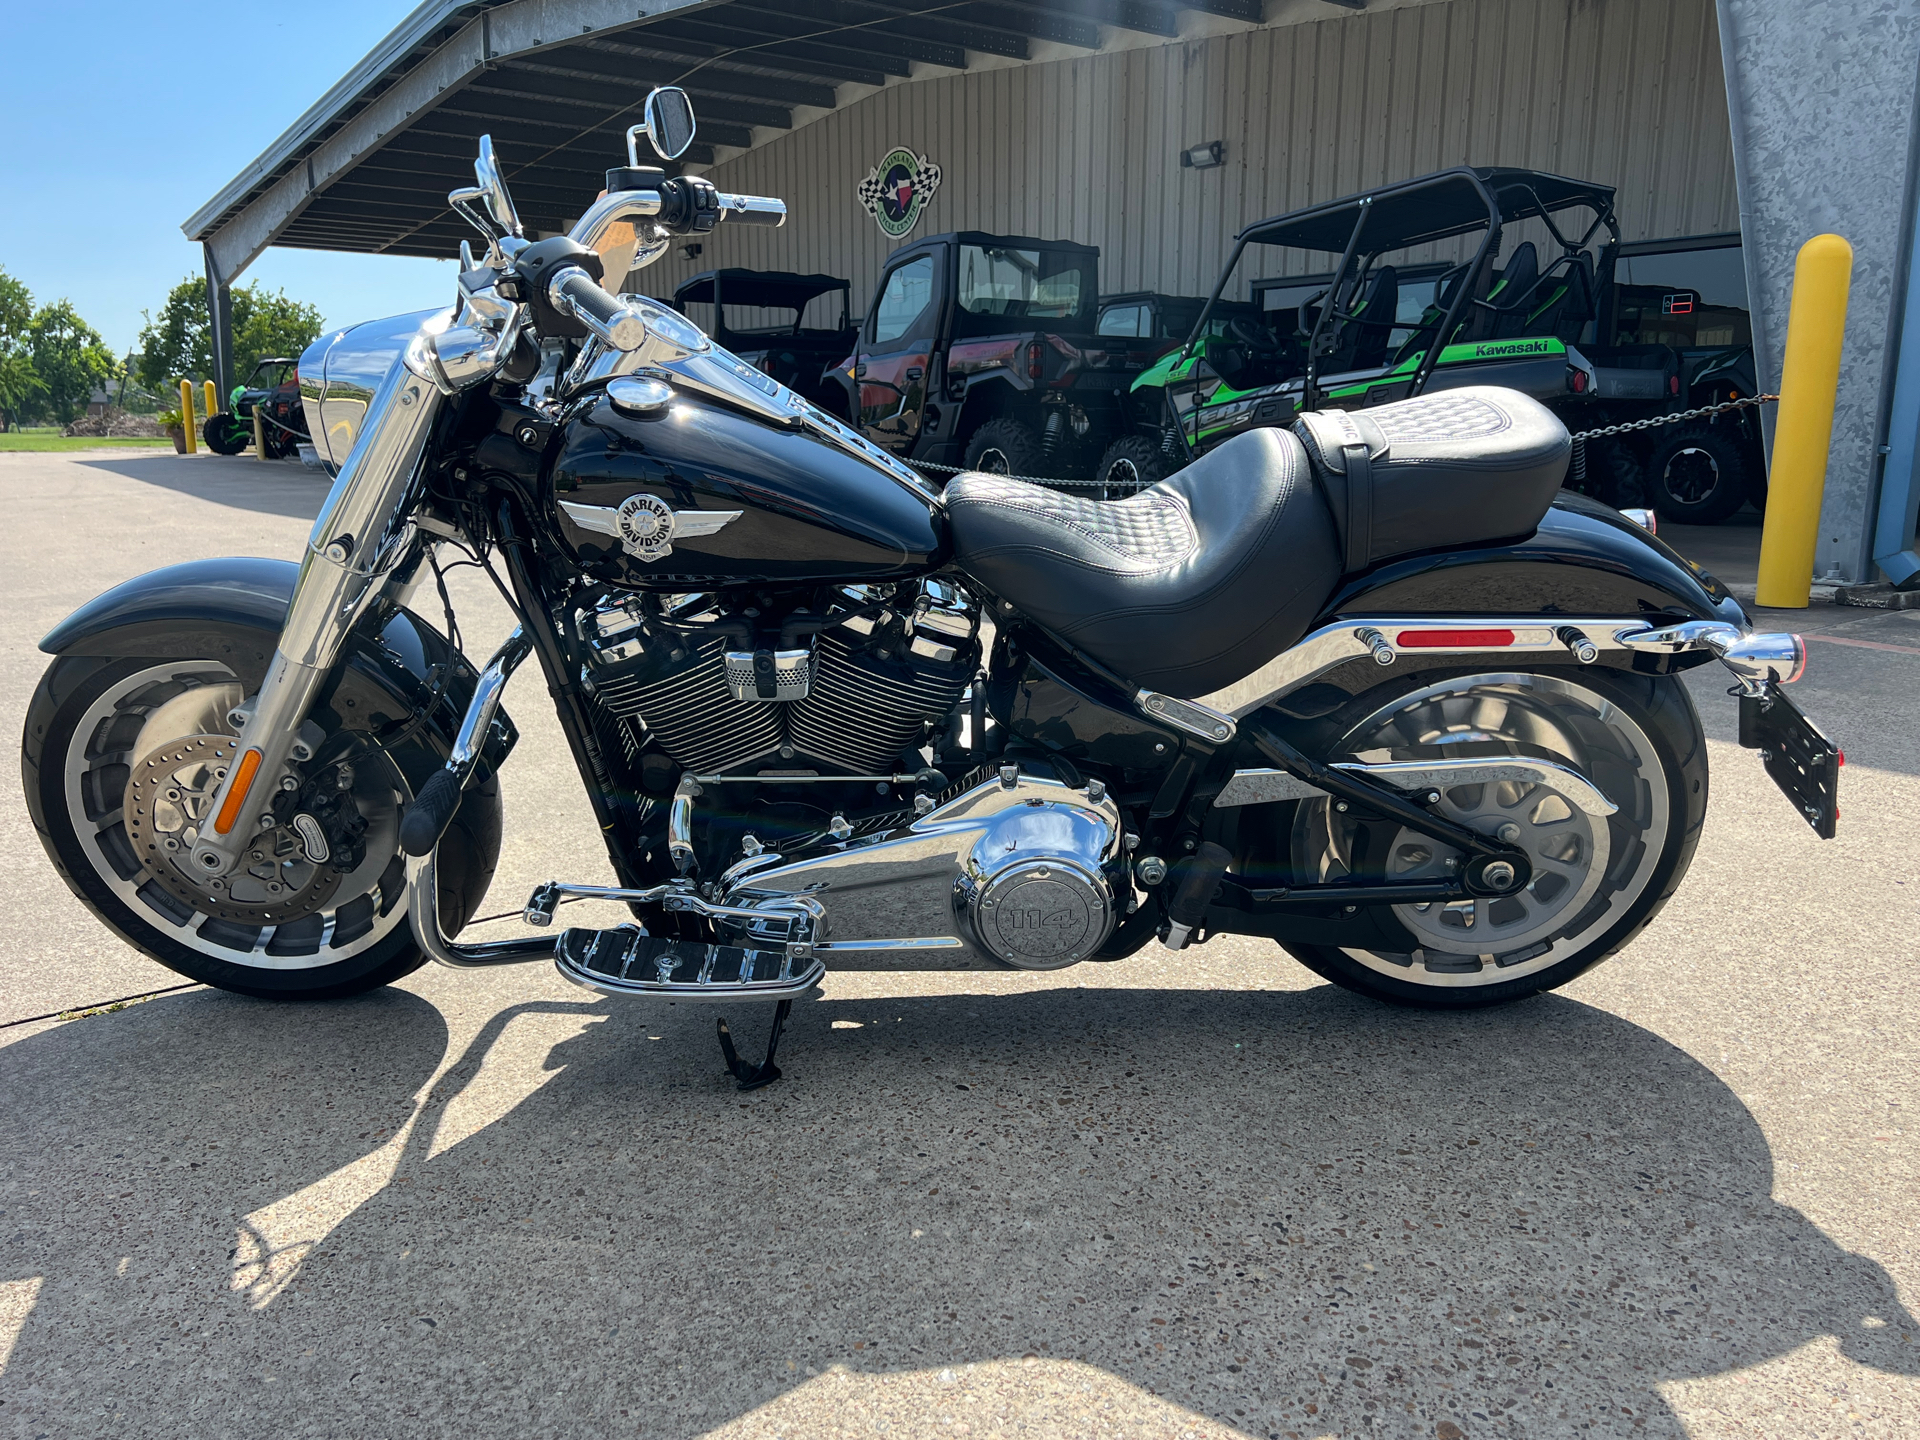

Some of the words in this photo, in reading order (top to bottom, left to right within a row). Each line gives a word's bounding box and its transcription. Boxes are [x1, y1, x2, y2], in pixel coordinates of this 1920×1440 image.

[882, 154, 914, 175] MAINLAND
[880, 211, 896, 231] CYCLE
[897, 205, 917, 231] CENTER
[1475, 340, 1549, 357] Kawasaki
[1087, 375, 1131, 388] Kawasa
[623, 499, 668, 518] HARLEY
[620, 522, 670, 547] DAVIDSON
[1010, 908, 1079, 929] 114
